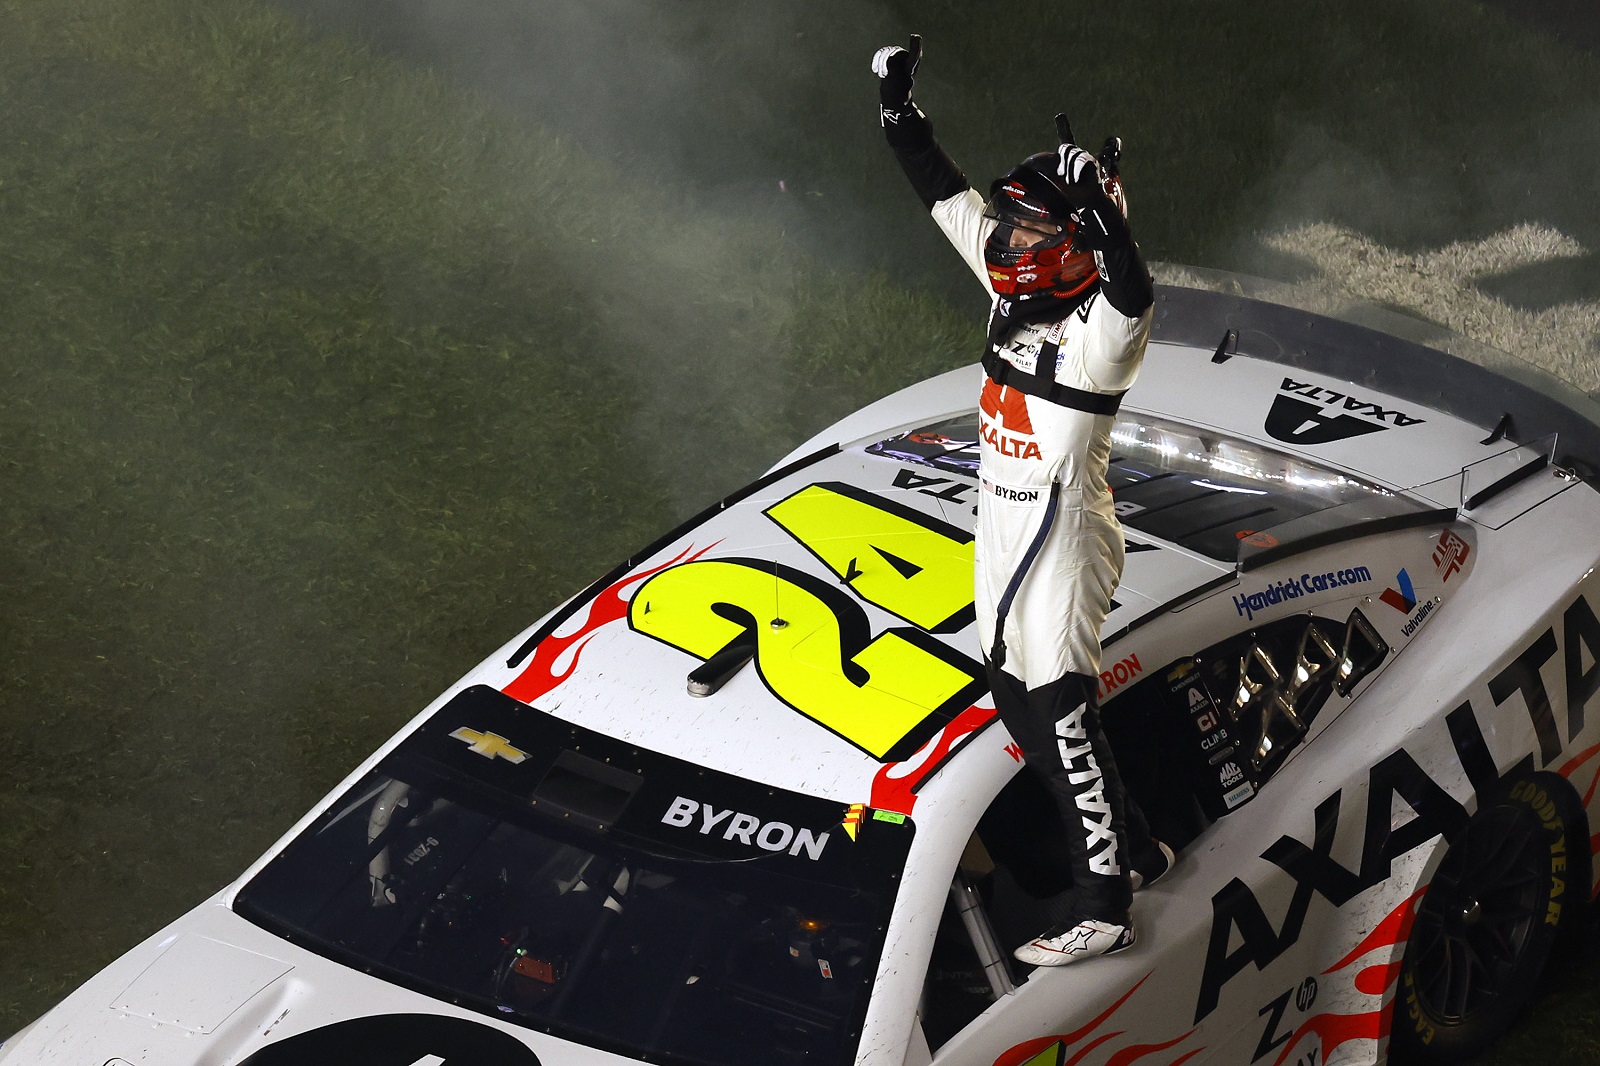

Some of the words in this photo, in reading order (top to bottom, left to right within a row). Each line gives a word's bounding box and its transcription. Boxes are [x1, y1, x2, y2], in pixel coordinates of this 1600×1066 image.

[1281, 377, 1427, 427] AXALTA
[979, 414, 1042, 461] XALTA
[994, 485, 1039, 503] BYRON
[1055, 701, 1121, 877] AXALTA
[1219, 761, 1242, 784] MAC
[1221, 772, 1244, 789] TOOLS
[660, 795, 831, 863] BYRON
[1508, 780, 1568, 928] GOODYEAR
[1298, 978, 1317, 1012] hp
